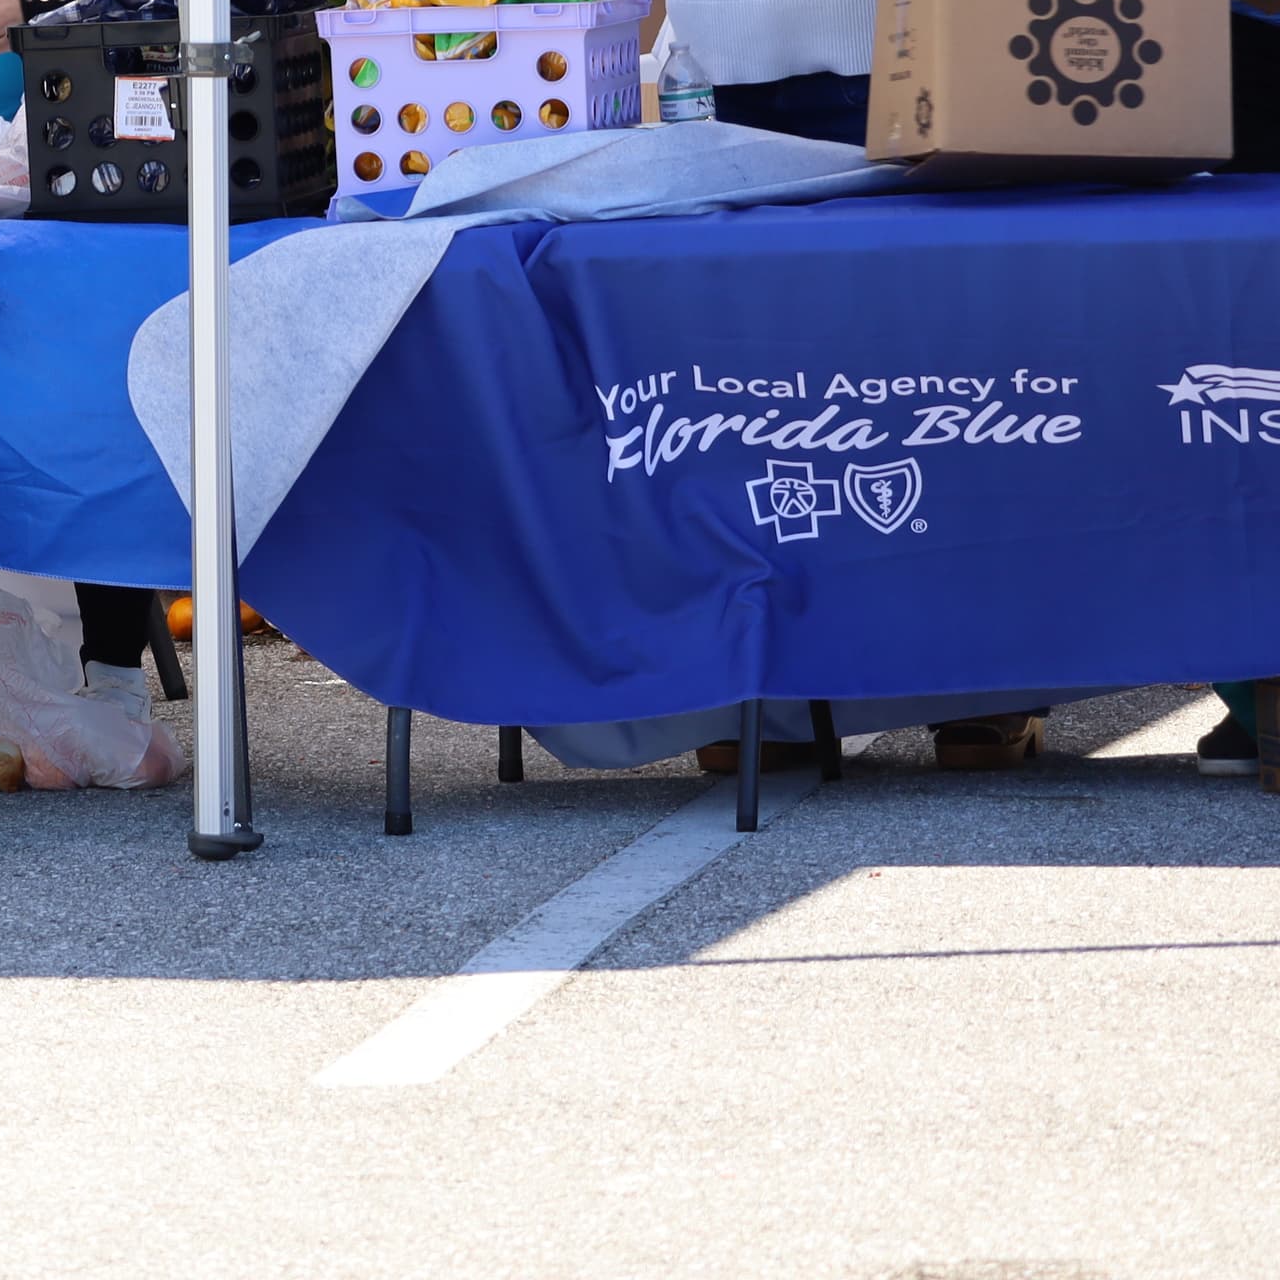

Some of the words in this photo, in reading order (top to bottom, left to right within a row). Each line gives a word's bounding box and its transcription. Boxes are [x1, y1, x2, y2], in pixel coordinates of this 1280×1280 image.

[595, 367, 677, 421] Your
[692, 365, 807, 400] Local
[823, 372, 994, 404] Agency
[1010, 368, 1079, 396] for
[607, 403, 894, 483] Florida
[901, 401, 1082, 446] Blue
[1180, 408, 1280, 445] INS
